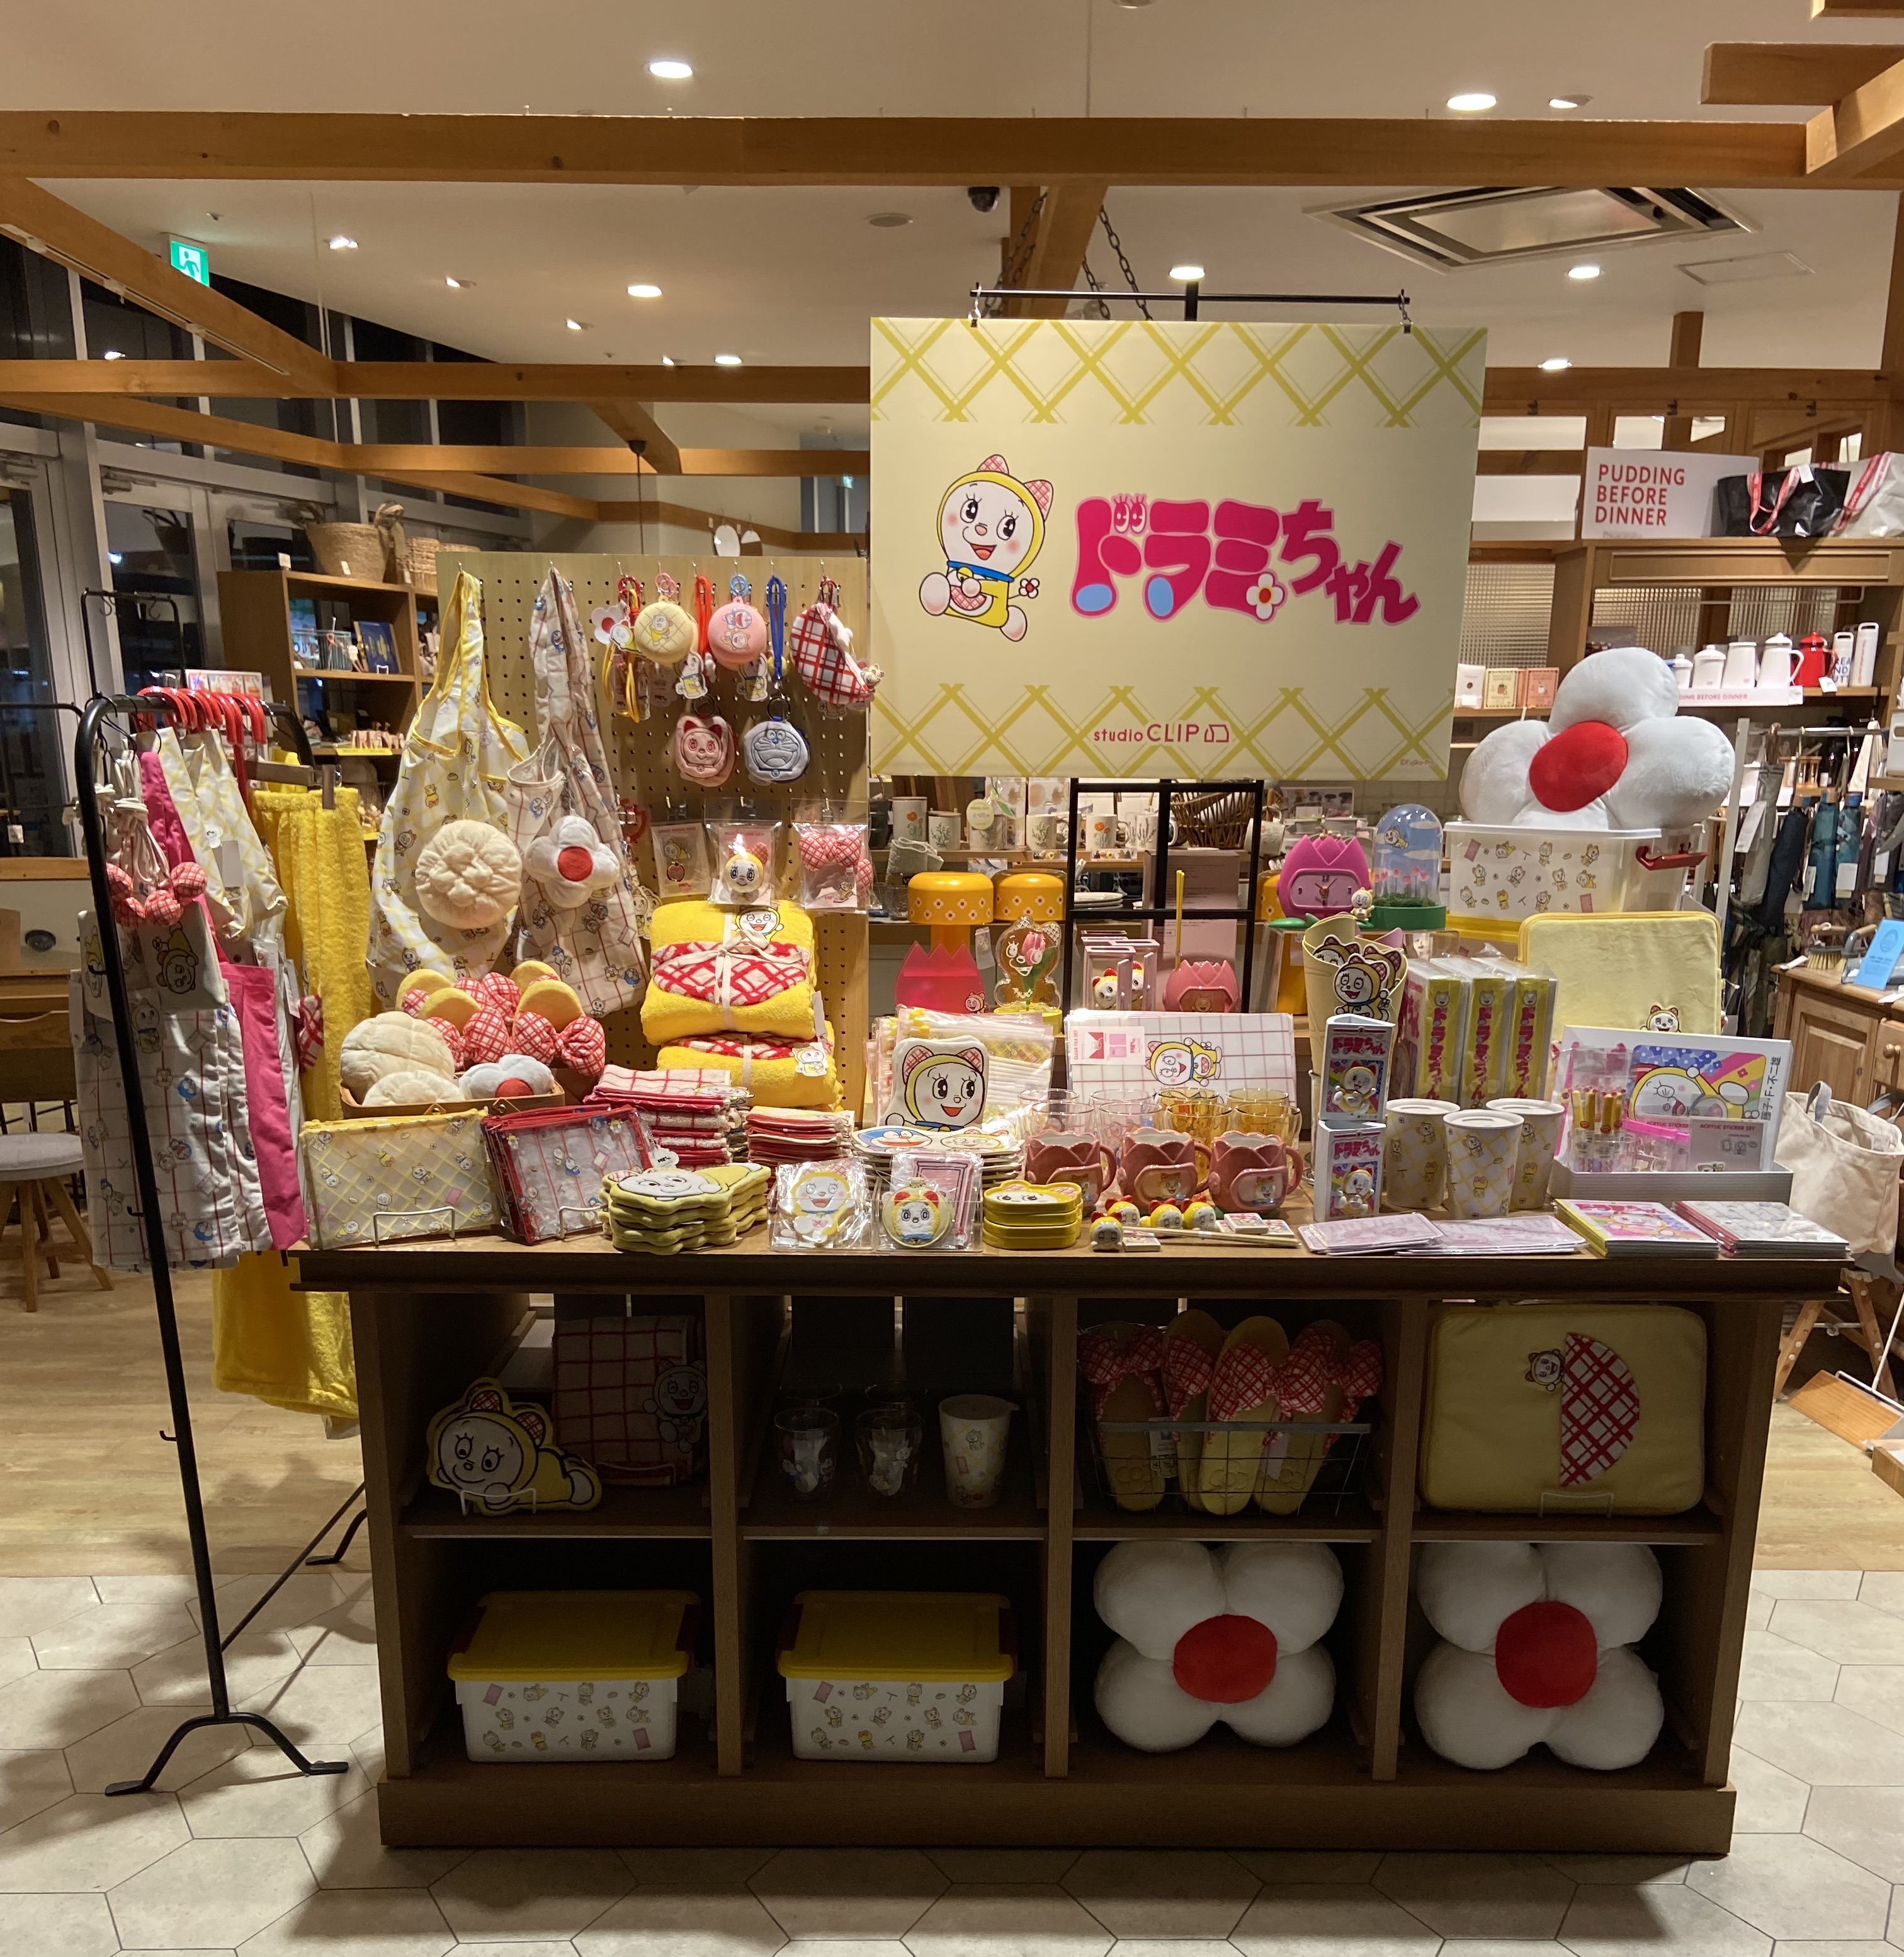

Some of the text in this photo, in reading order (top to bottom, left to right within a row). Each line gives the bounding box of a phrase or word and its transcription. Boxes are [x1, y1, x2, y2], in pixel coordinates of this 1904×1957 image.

[1599, 463, 1686, 485] PUDDING
[1597, 485, 1667, 506] BEFORE
[1595, 506, 1667, 526] DINNER
[1070, 493, 1421, 625] ドラミちゃん
[1147, 723, 1199, 742] CLIP
[1332, 1036, 1386, 1055] ドラミちゃん
[1333, 1140, 1381, 1160] ドラミちゃん
